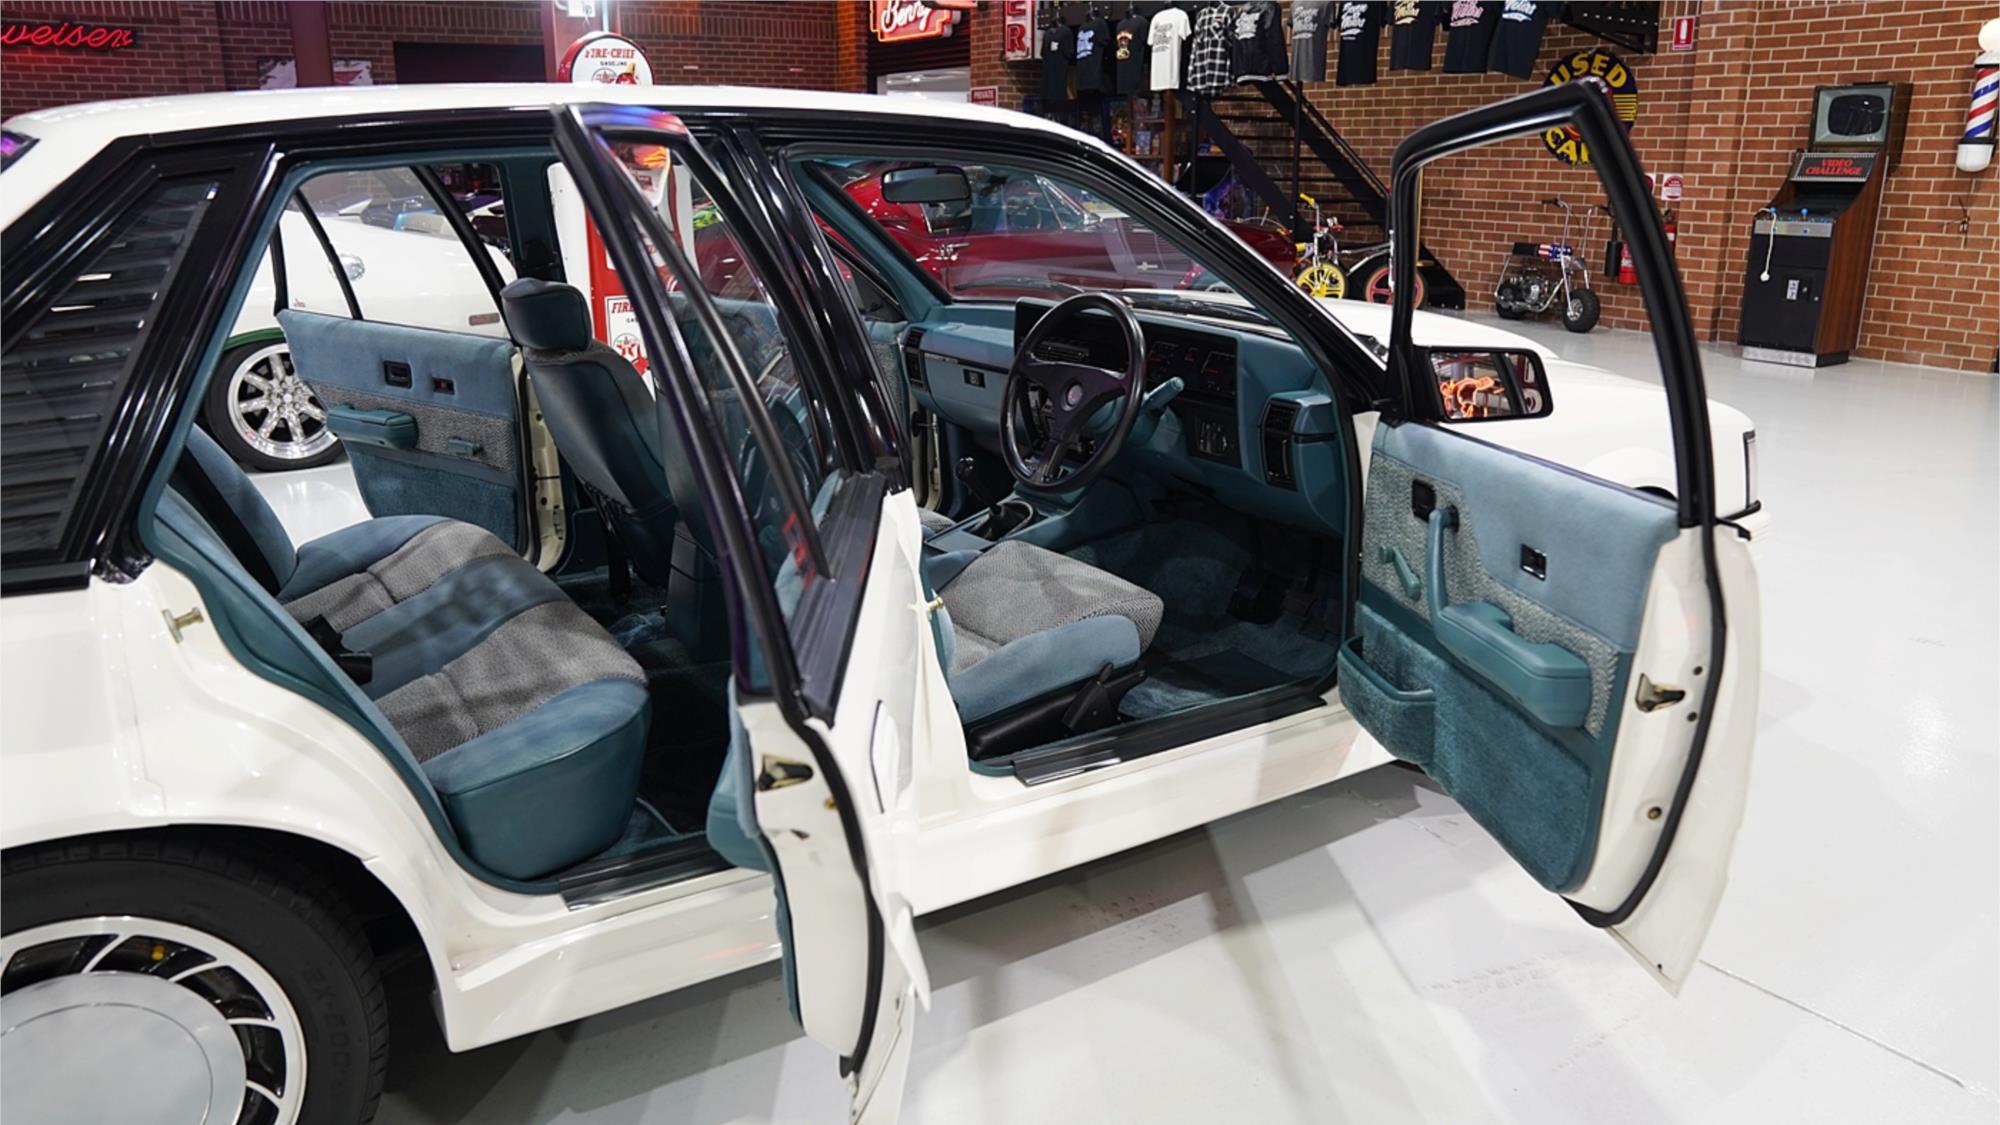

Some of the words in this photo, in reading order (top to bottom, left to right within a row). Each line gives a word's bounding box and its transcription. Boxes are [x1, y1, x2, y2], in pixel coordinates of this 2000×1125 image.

[1550, 53, 1627, 88] USED
[1822, 159, 1854, 168] VIDEO
[1805, 167, 1864, 176] CHALLENGE
